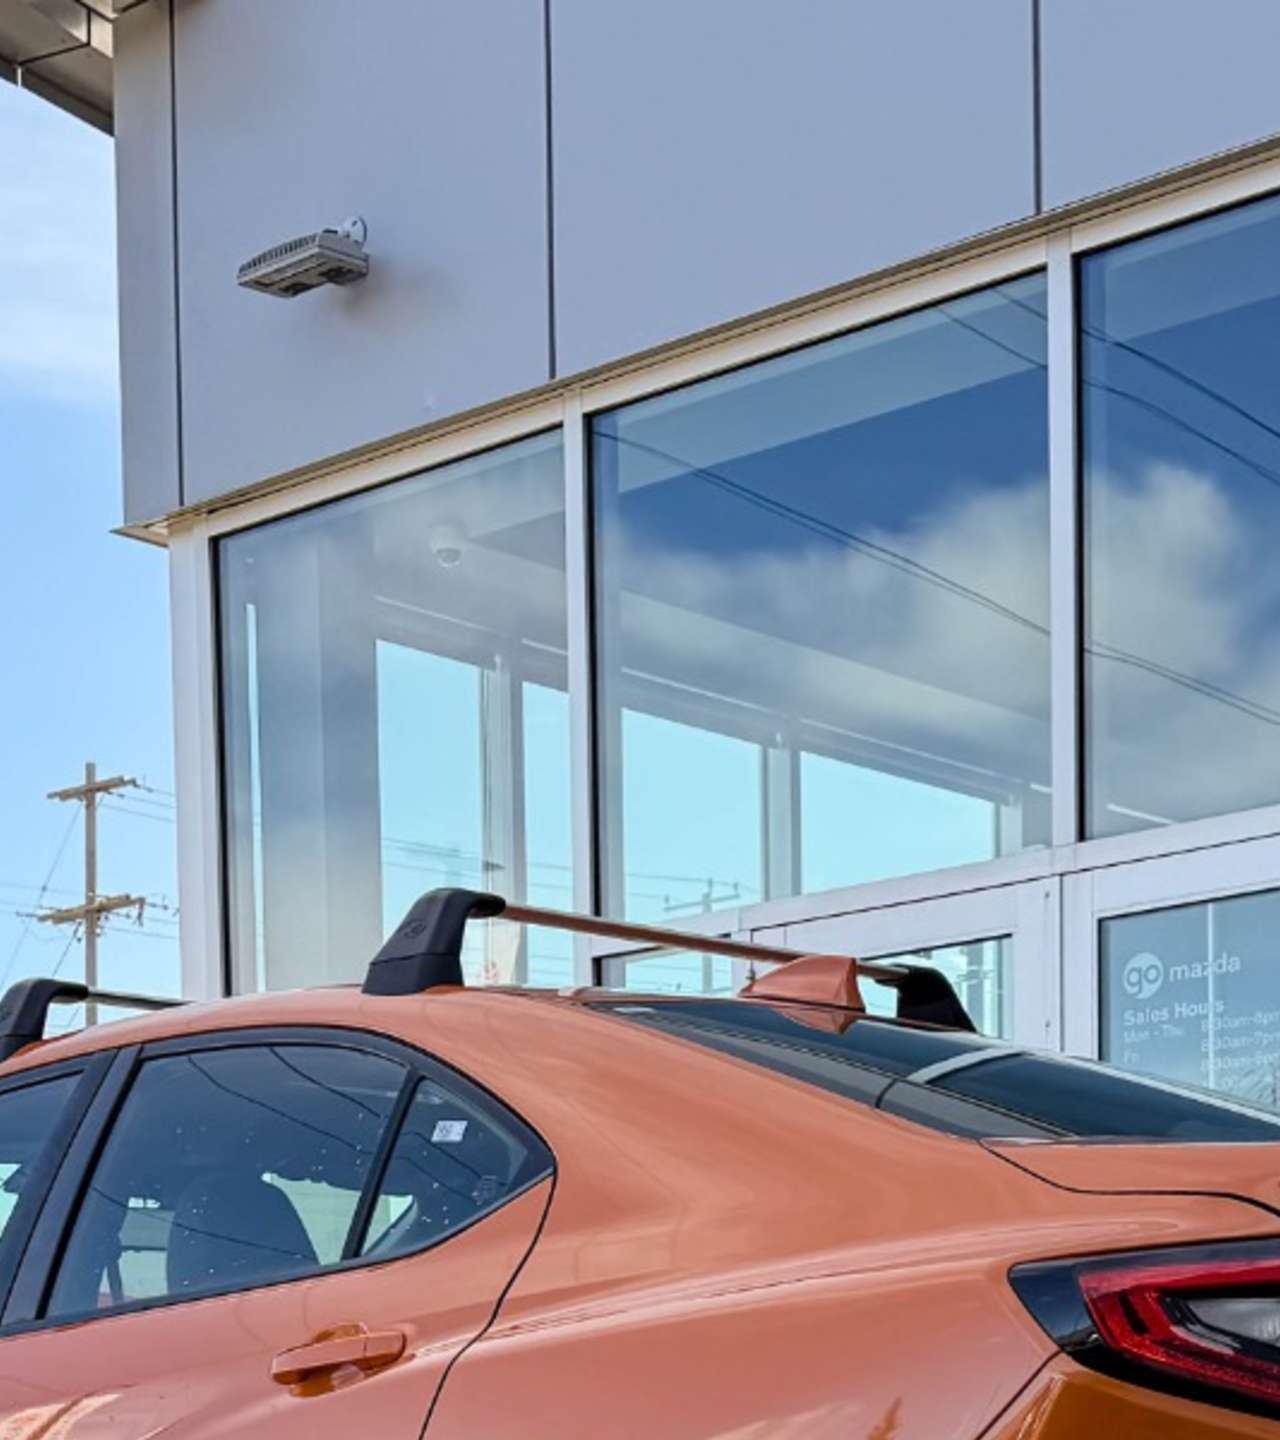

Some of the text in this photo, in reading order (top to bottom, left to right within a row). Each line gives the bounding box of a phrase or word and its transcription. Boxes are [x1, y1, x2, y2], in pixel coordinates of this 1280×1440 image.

[1125, 963, 1162, 997] go
[1123, 1000, 1225, 1027] Sales Hous
